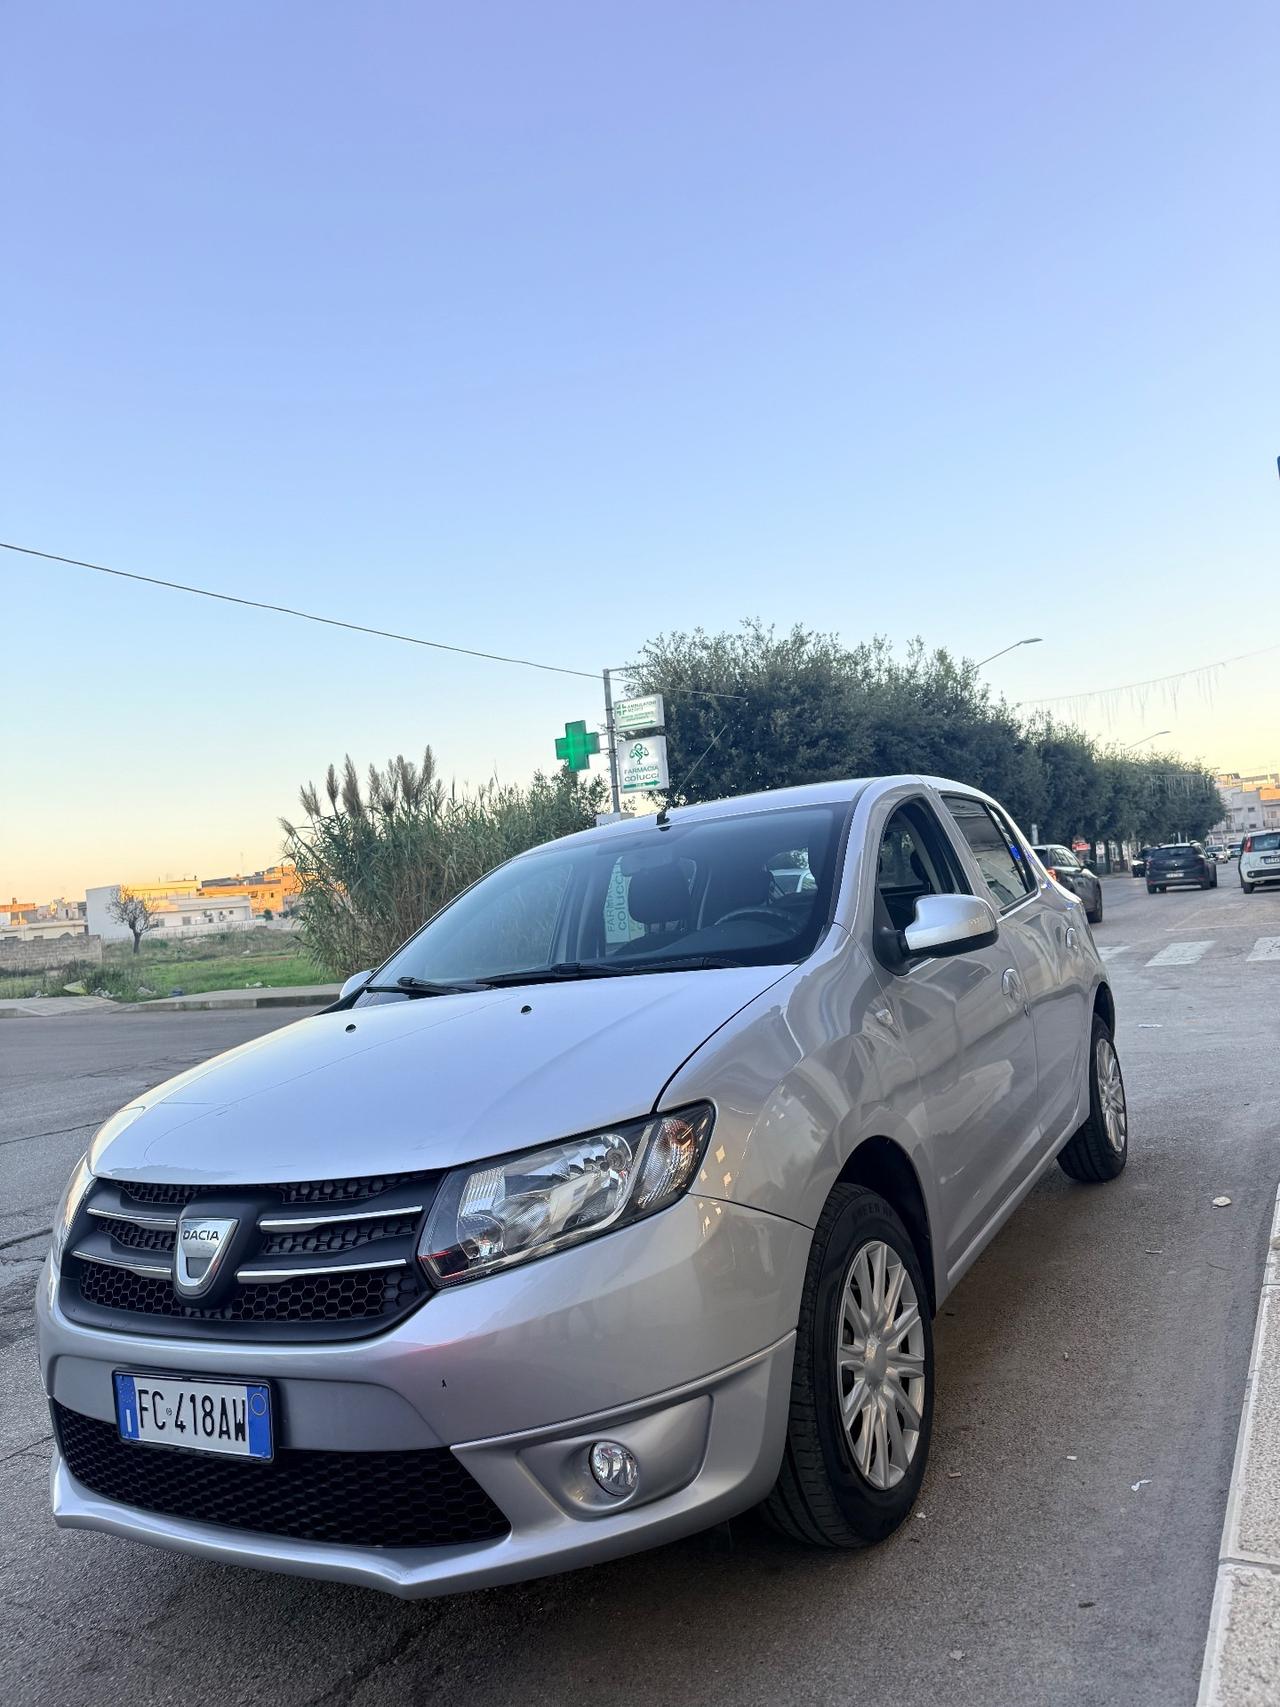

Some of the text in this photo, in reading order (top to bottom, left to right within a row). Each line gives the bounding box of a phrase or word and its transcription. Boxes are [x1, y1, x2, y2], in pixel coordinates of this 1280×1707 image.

[624, 765, 659, 775] FARMACIA
[183, 1230, 219, 1240] DACIA
[137, 1389, 247, 1442] FC 418AW
